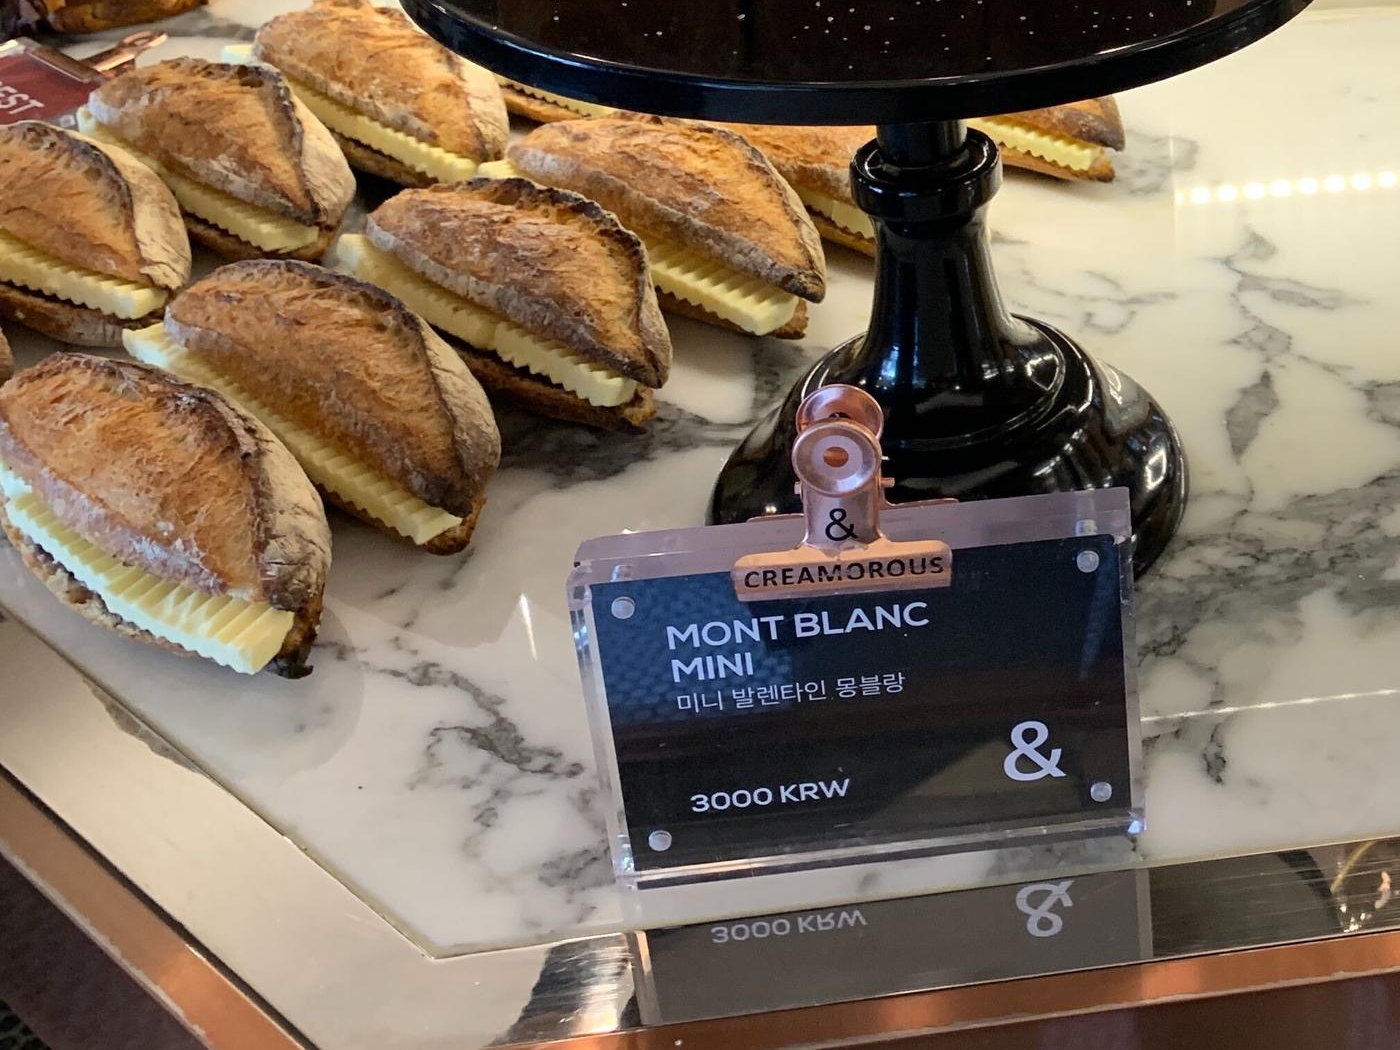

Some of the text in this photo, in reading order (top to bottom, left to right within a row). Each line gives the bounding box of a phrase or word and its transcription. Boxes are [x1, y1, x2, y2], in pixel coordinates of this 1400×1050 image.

[0, 80, 45, 115] EST
[825, 507, 858, 542] &
[743, 557, 944, 589] CREAMOROUS
[666, 601, 930, 650] MONT BLANC
[671, 652, 754, 684] MINI
[677, 673, 906, 714] 미니 발렌타인 몽블랑
[1003, 720, 1067, 782] &
[690, 778, 850, 813] 3000 KRW
